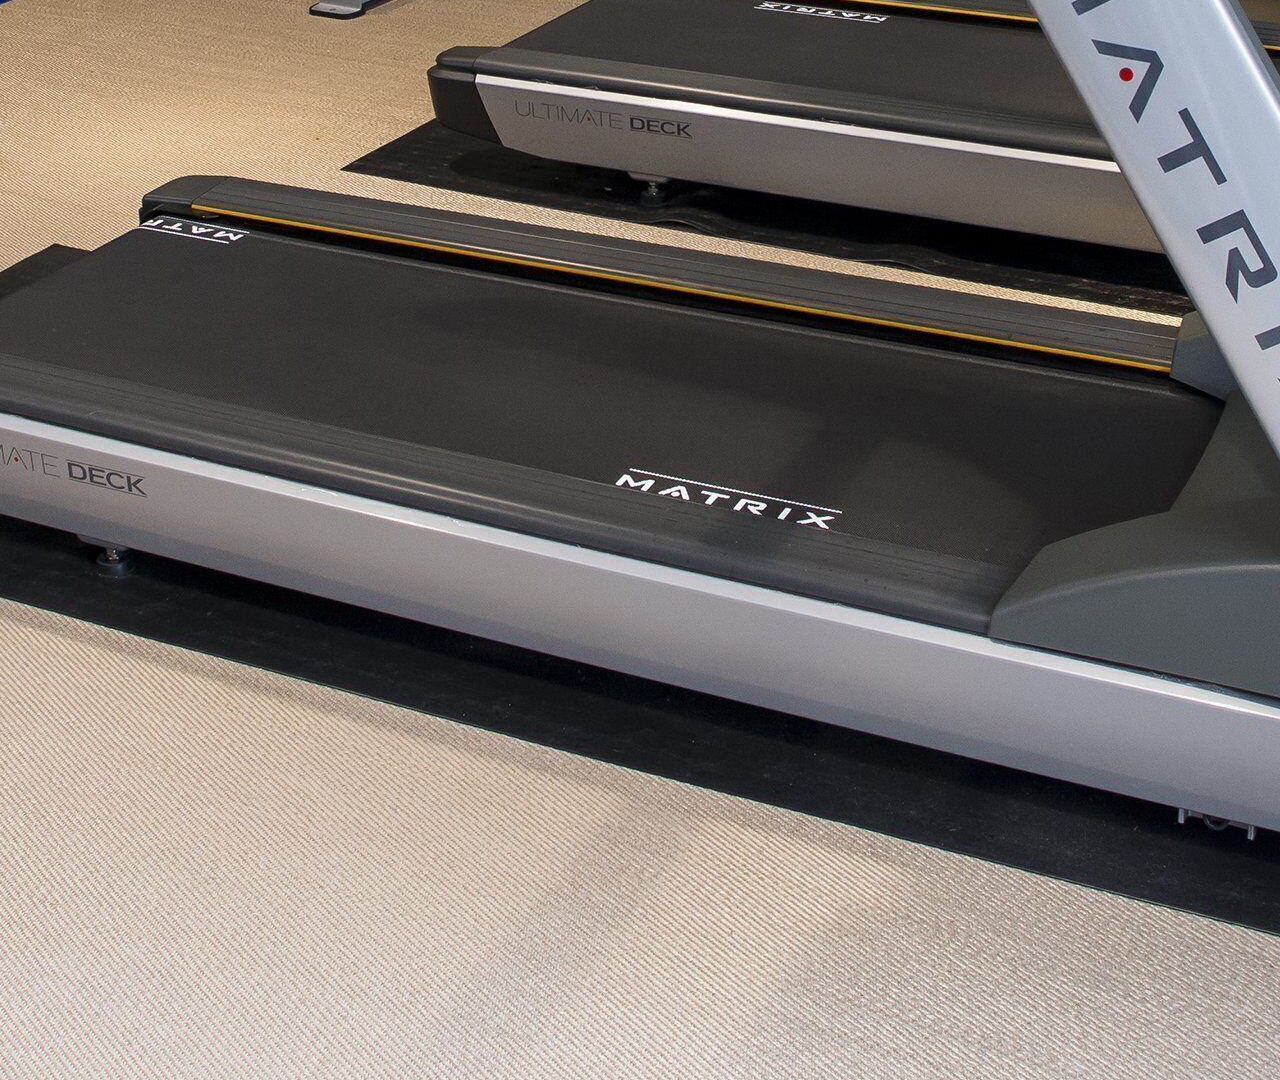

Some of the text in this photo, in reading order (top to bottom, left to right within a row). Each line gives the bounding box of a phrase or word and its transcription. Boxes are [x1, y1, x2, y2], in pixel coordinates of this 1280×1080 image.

[760, 1, 887, 22] MATRIX
[514, 100, 693, 138] ULTIMATE DECK
[141, 219, 245, 242] MATR
[67, 461, 148, 497] DECK
[615, 473, 835, 530] MATRIX
